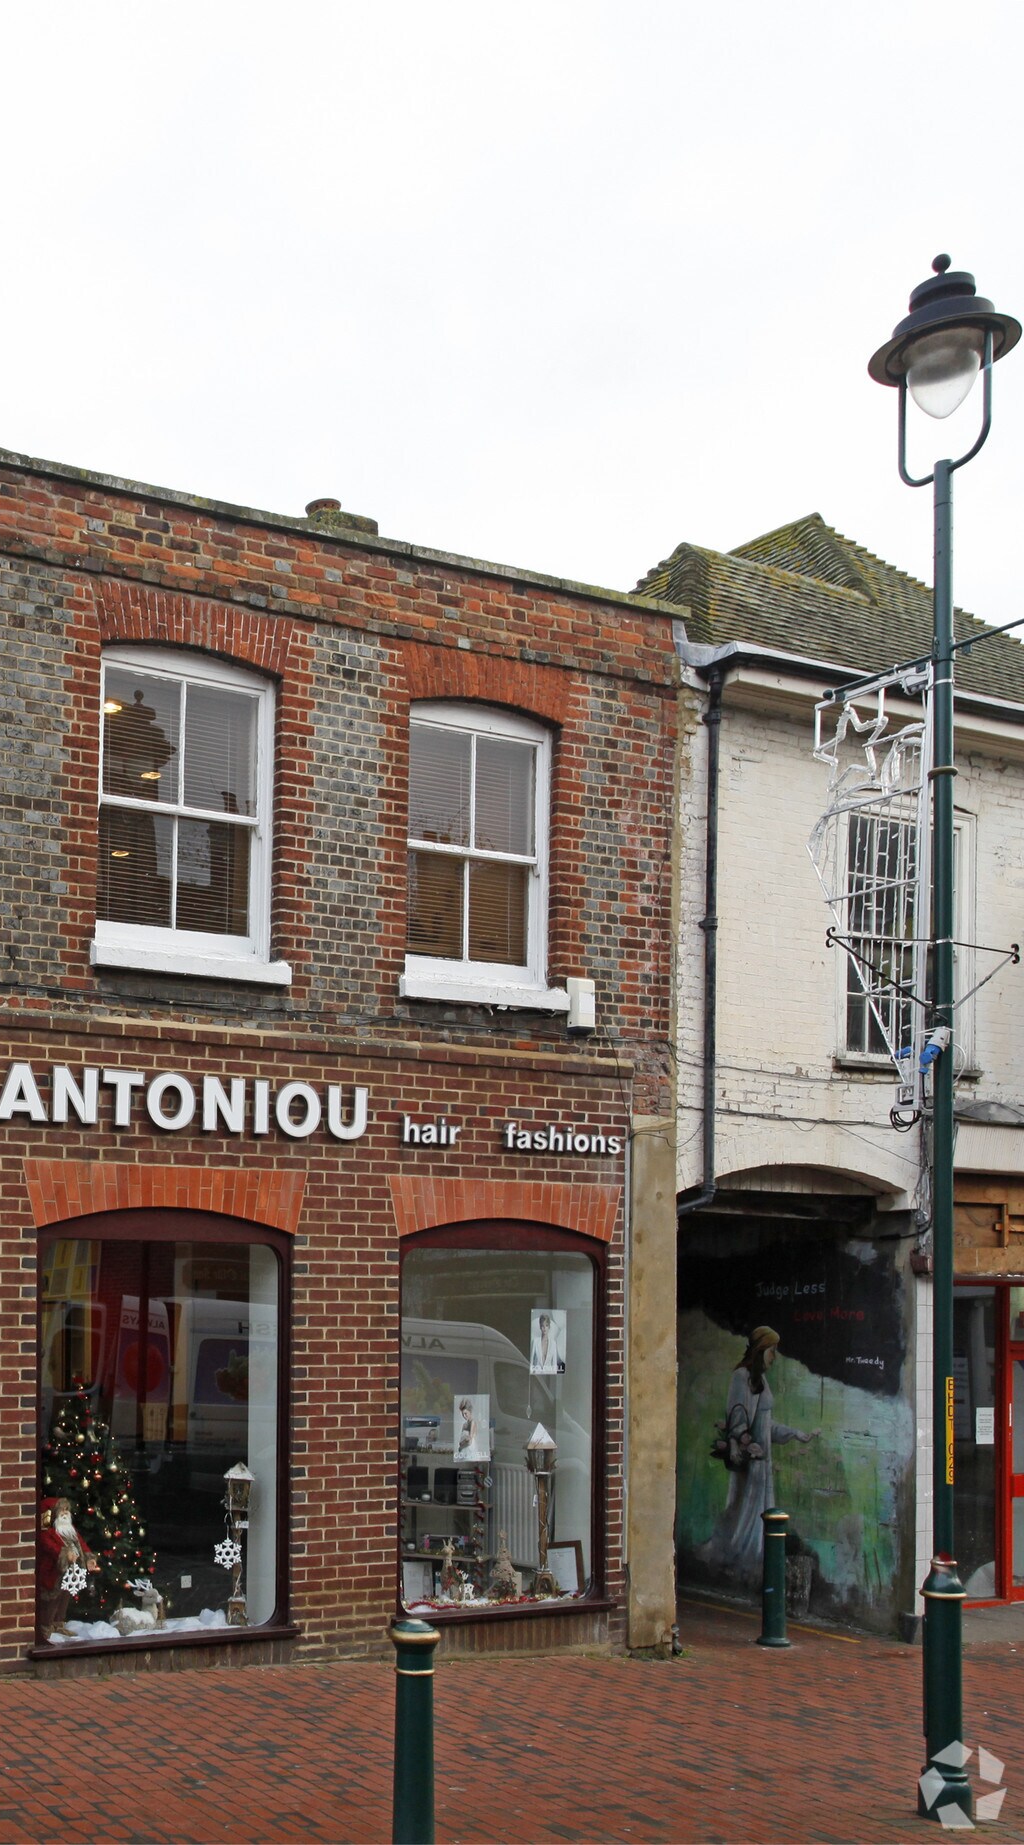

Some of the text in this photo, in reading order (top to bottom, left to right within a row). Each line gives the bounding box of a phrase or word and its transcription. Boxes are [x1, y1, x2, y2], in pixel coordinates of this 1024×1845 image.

[402, 1115, 621, 1154] hair fashions
[755, 1281, 826, 1300] Judge Less
[856, 1357, 885, 1370] Tweedy
